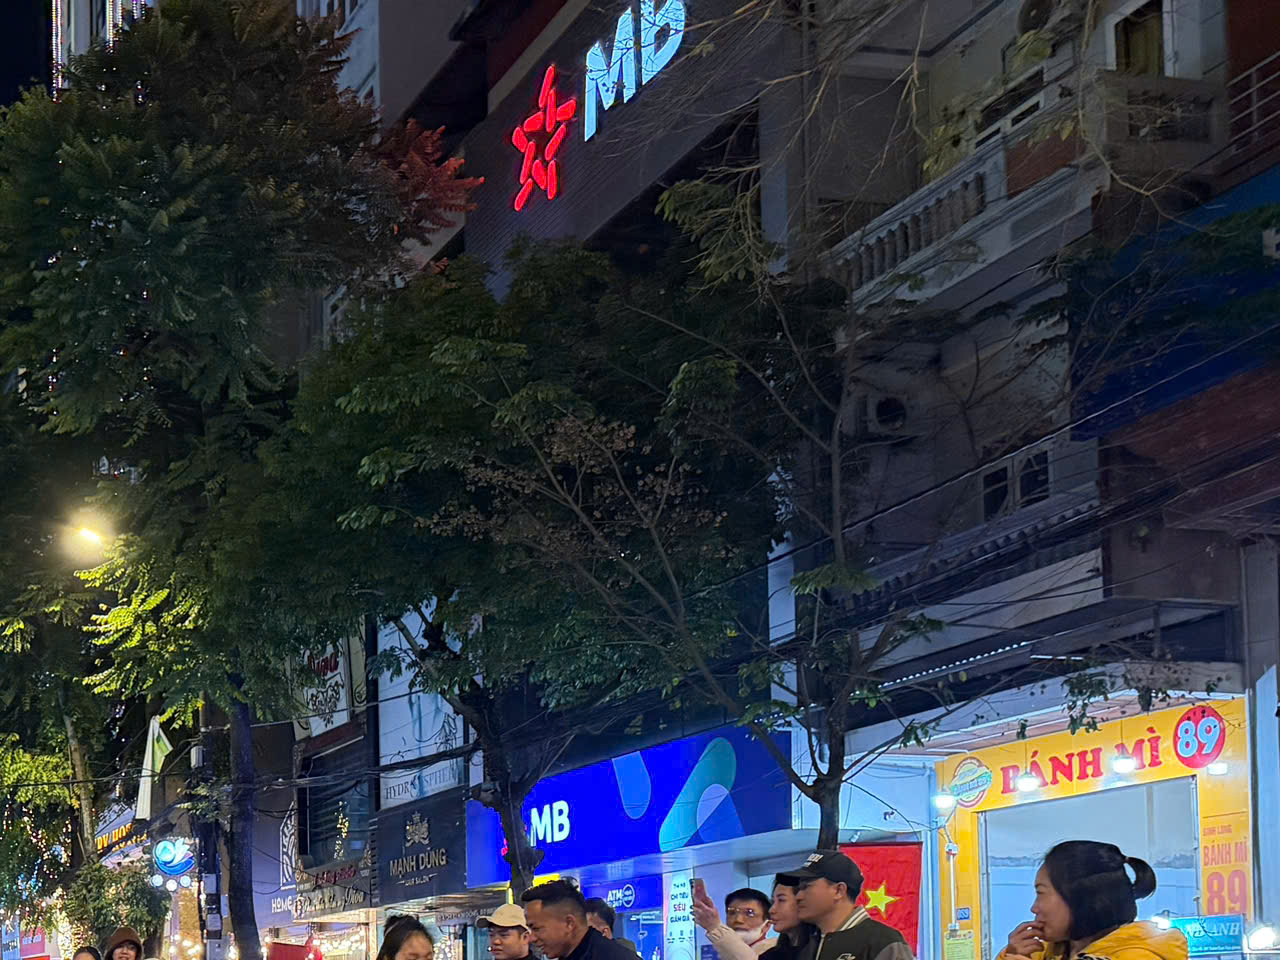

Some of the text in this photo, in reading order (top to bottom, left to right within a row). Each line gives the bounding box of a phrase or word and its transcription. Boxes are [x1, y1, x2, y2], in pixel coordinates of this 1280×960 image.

[584, 0, 686, 142] MB
[1000, 750, 1104, 795] BÁNH
[1176, 716, 1221, 758] 89
[530, 800, 570, 847] MB
[389, 855, 417, 879] MẠNH
[1203, 840, 1232, 866] BÁNH
[607, 889, 623, 901] ATM
[1206, 869, 1248, 916] 89
